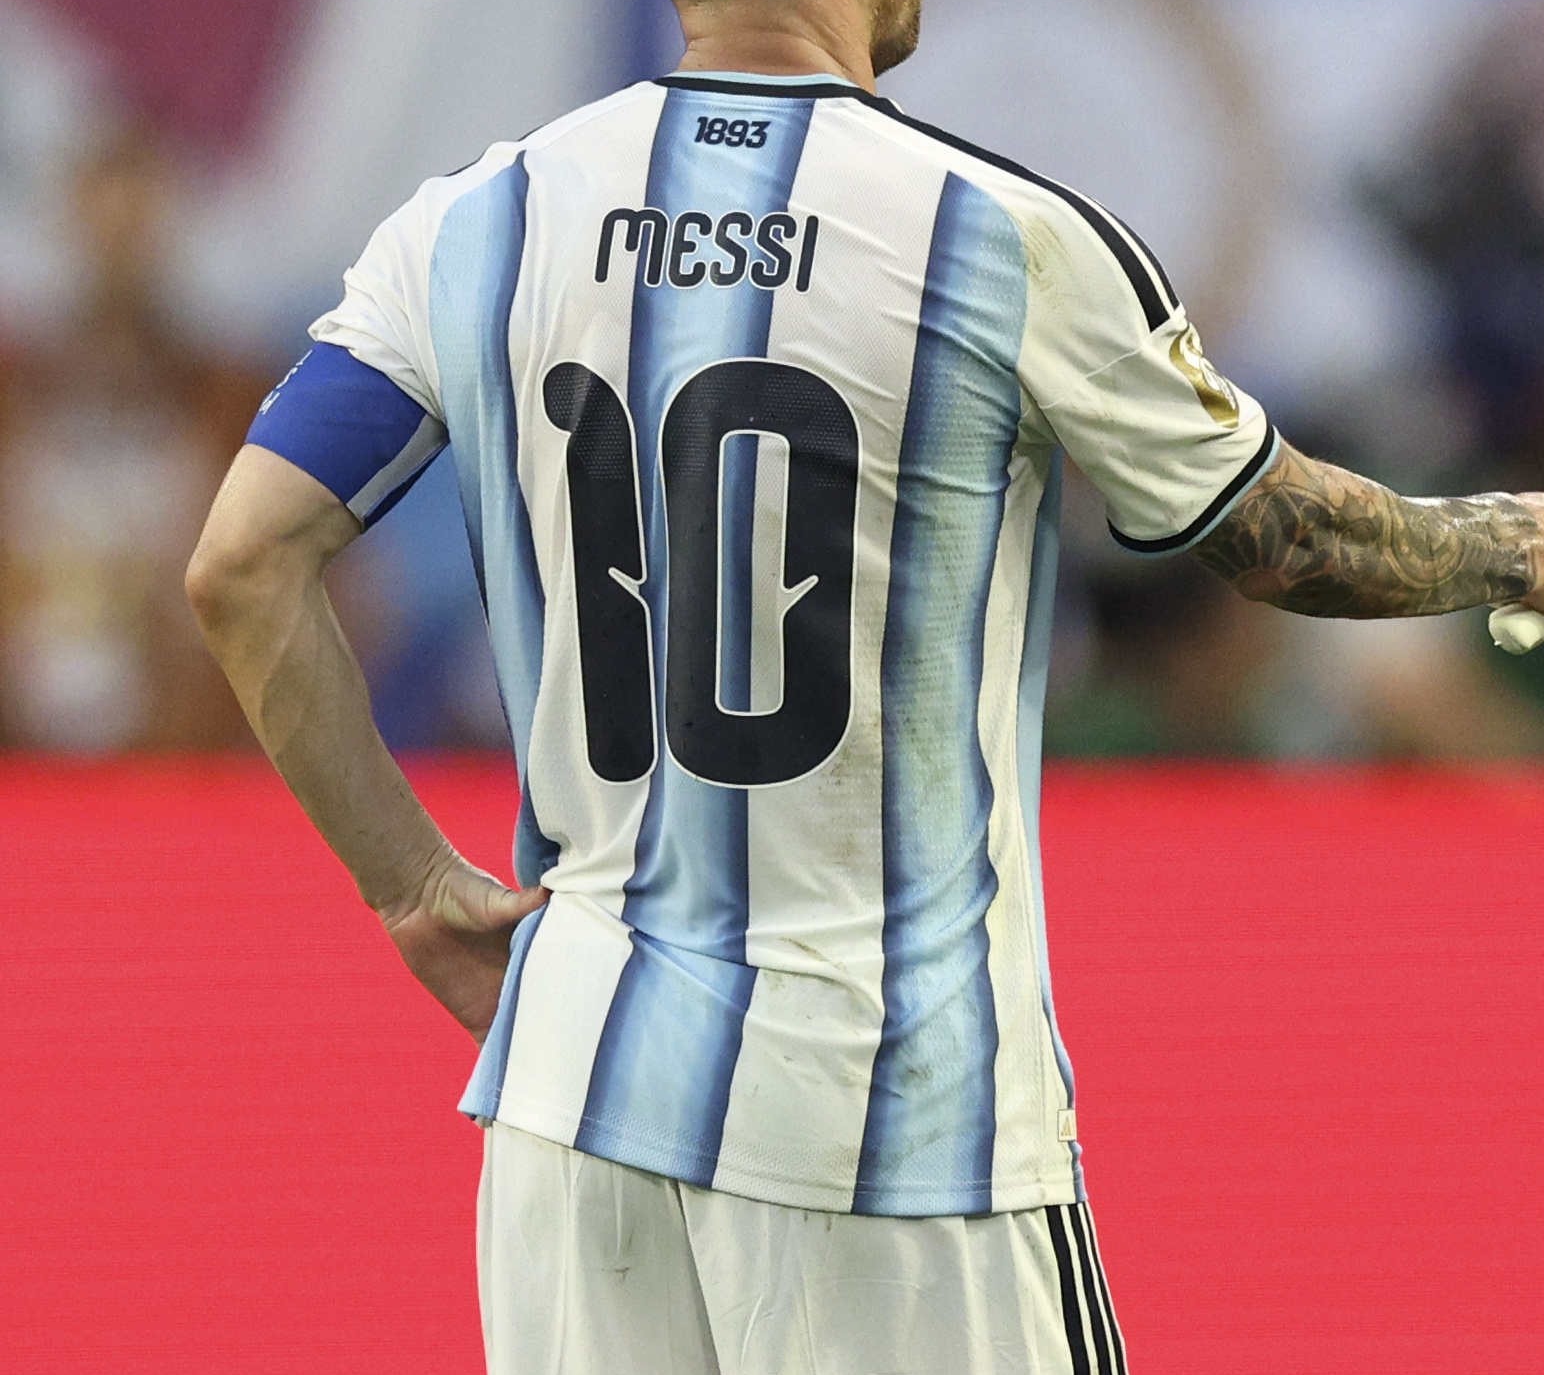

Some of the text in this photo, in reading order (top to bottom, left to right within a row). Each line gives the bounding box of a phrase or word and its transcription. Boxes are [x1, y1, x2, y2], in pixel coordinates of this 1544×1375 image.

[694, 116, 771, 148] 1893
[594, 206, 819, 293] MESSI
[541, 357, 863, 788] 10
